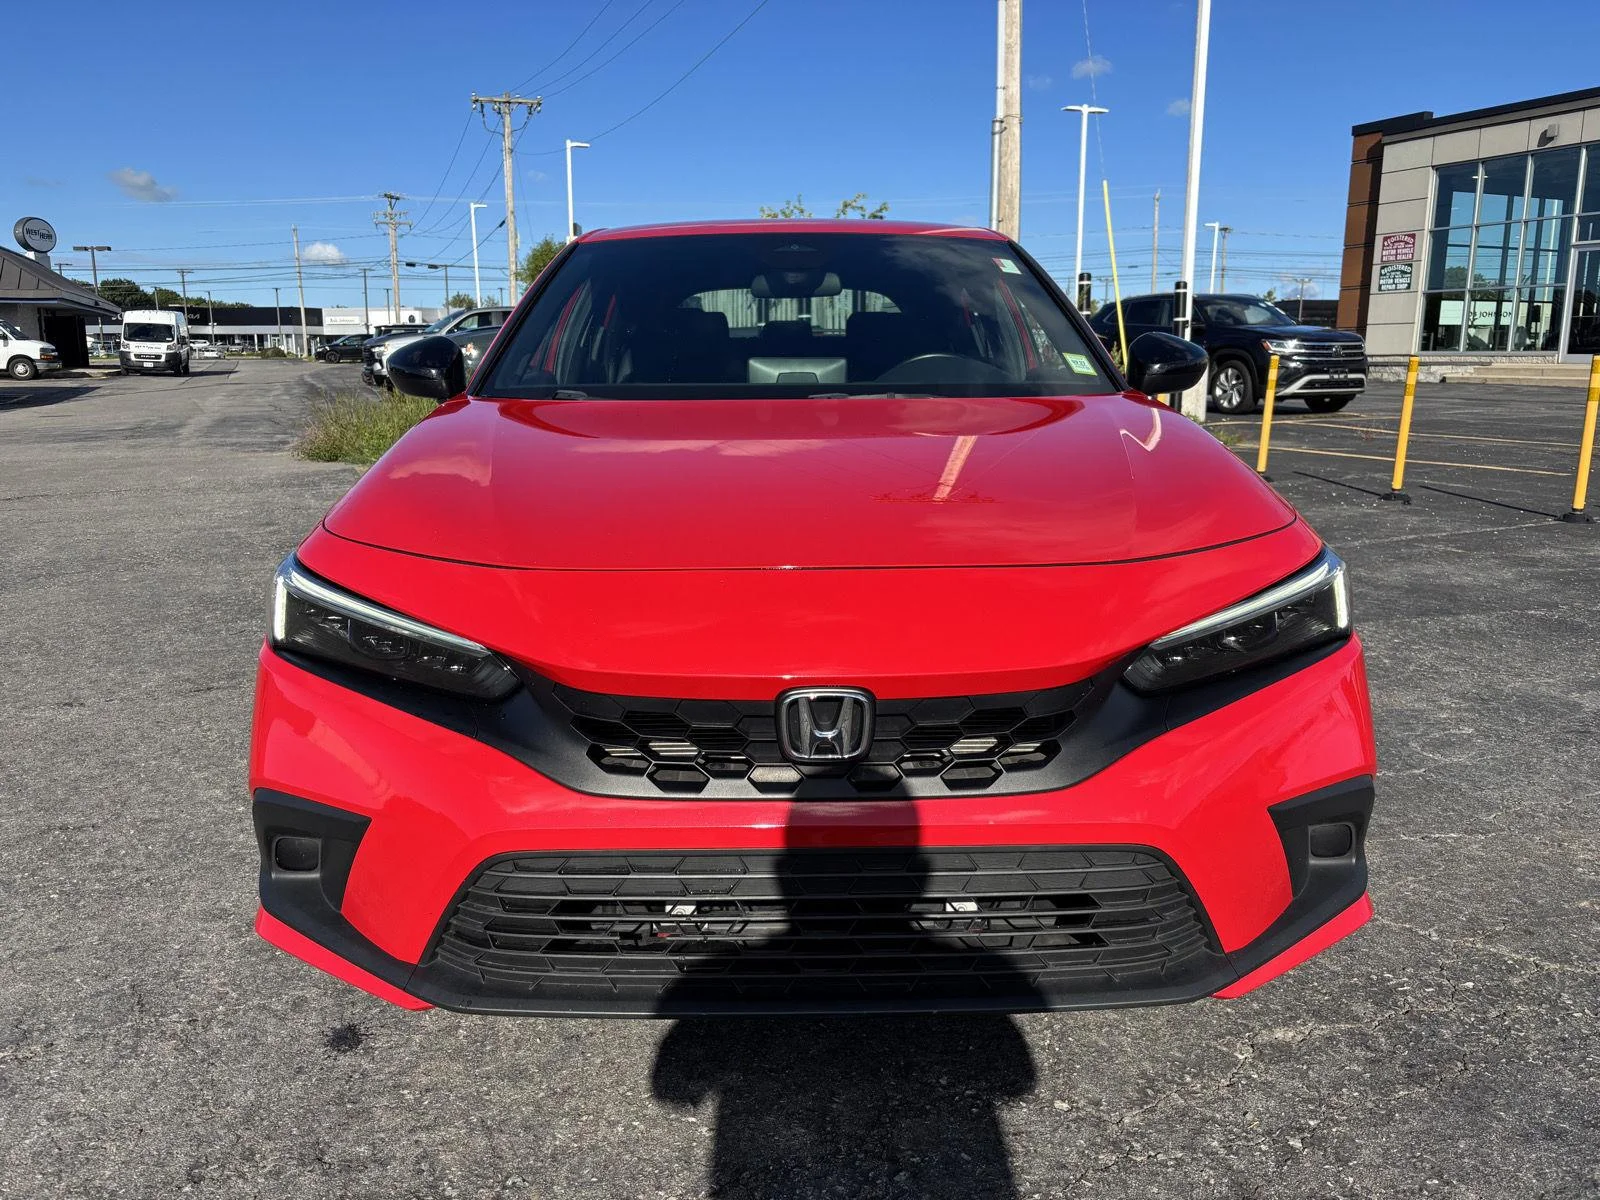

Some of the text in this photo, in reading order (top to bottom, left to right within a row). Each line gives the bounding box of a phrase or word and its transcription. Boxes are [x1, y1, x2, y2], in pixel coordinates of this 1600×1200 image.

[25, 227, 40, 236] WEST
[1384, 236, 1413, 246] REGISTERED
[1381, 265, 1411, 275] REGISTERED
